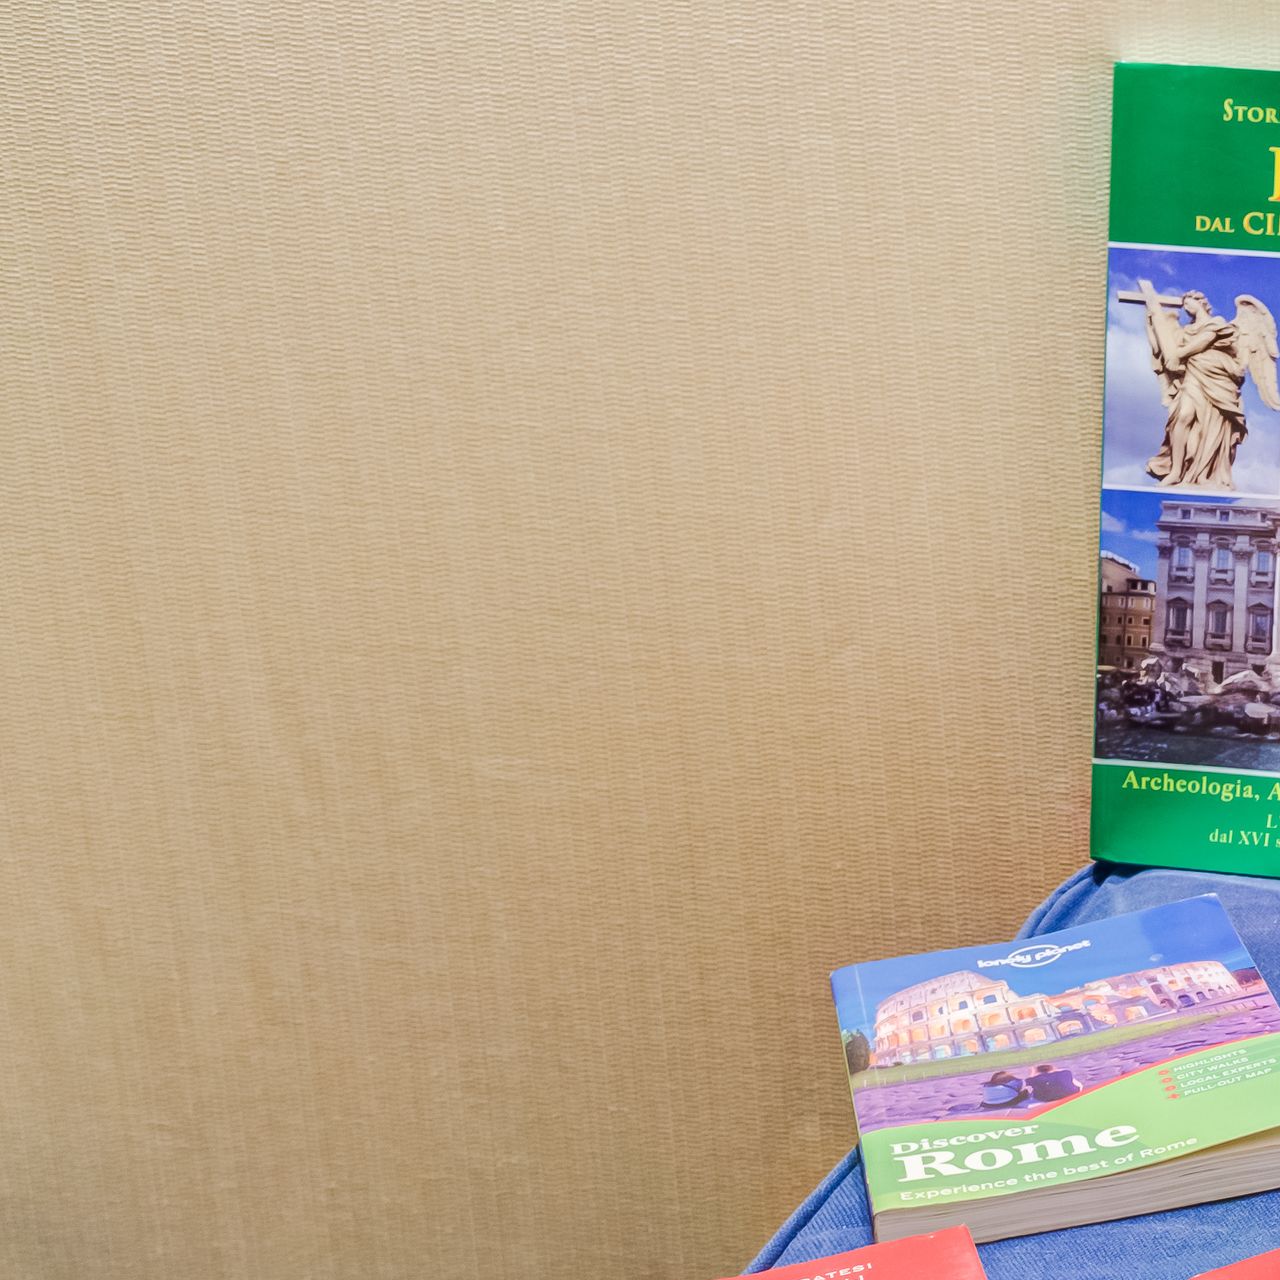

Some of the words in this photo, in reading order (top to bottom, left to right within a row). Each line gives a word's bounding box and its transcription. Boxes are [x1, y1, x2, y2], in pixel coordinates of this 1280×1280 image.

[1195, 215, 1235, 233] DAL
[1122, 770, 1260, 802] Archeologia,
[1209, 828, 1233, 844] dal
[1238, 830, 1270, 846] XVI
[977, 955, 1032, 968] lonely
[1035, 940, 1091, 960] planet
[1174, 1049, 1246, 1072] HIGHLIGHTS
[1177, 1069, 1204, 1080] CITY
[1207, 1057, 1248, 1071] WALKS
[1180, 1074, 1220, 1088] LOCAL
[1222, 1058, 1277, 1076] EXPERTS
[1246, 1068, 1272, 1078] MAP
[890, 1124, 1039, 1156] Discover
[896, 1124, 1140, 1183] Rome
[899, 1177, 1018, 1202] Experience
[1024, 1169, 1059, 1184] the
[1063, 1159, 1108, 1177] best
[1113, 1153, 1136, 1170] of
[1141, 1137, 1198, 1159] Rome
